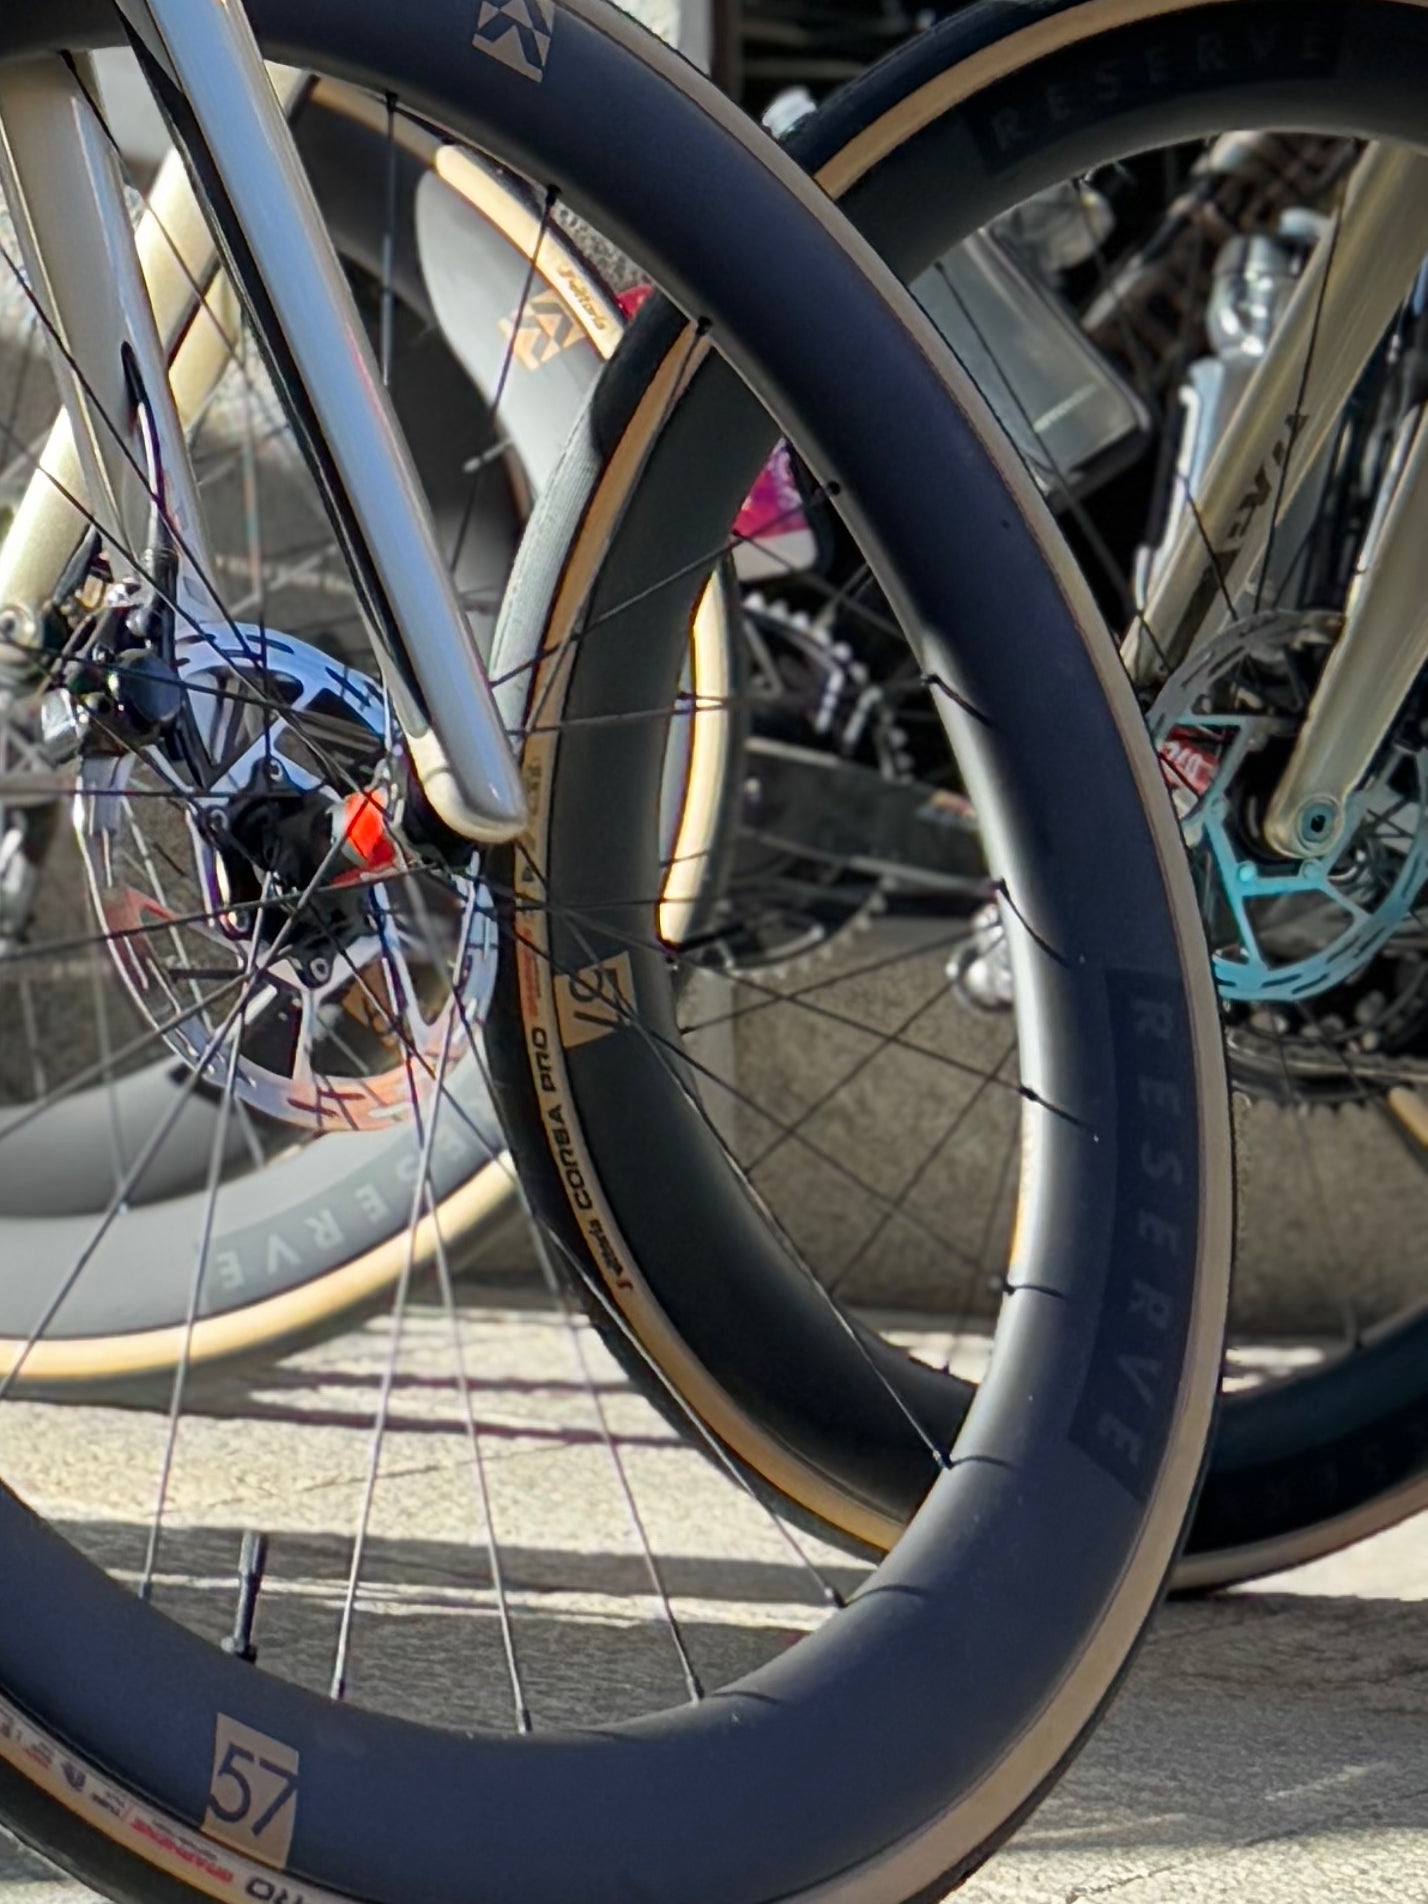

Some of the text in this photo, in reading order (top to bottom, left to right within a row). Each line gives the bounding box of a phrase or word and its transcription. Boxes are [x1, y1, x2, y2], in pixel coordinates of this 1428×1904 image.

[528, 1026, 557, 1093] PRO
[545, 1104, 593, 1211] CORSA
[216, 1135, 469, 1291] ESERVE
[1096, 995, 1184, 1468] RESERVE
[209, 1743, 299, 1837] 57
